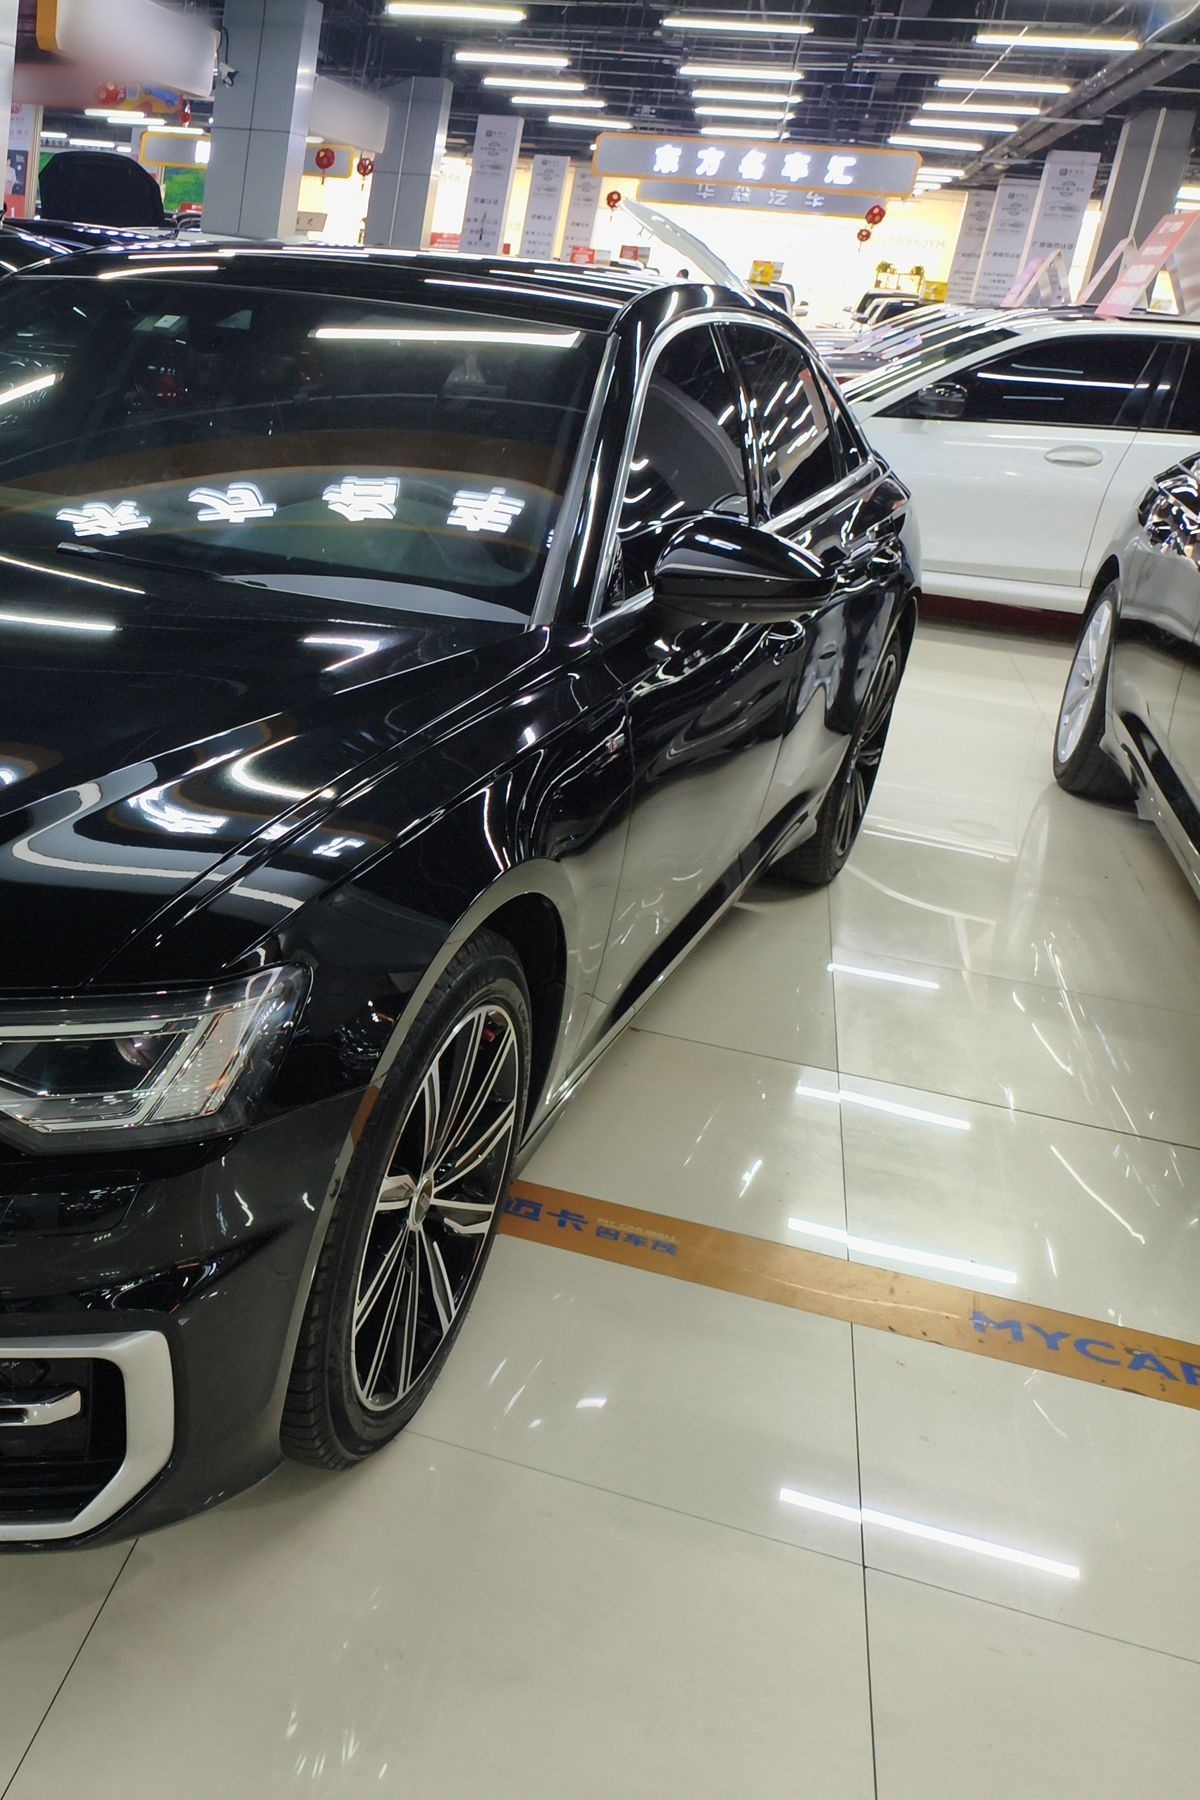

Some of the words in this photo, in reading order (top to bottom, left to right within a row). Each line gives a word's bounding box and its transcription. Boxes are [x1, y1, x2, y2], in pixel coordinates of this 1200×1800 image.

[653, 144, 856, 185] 东方名车汇
